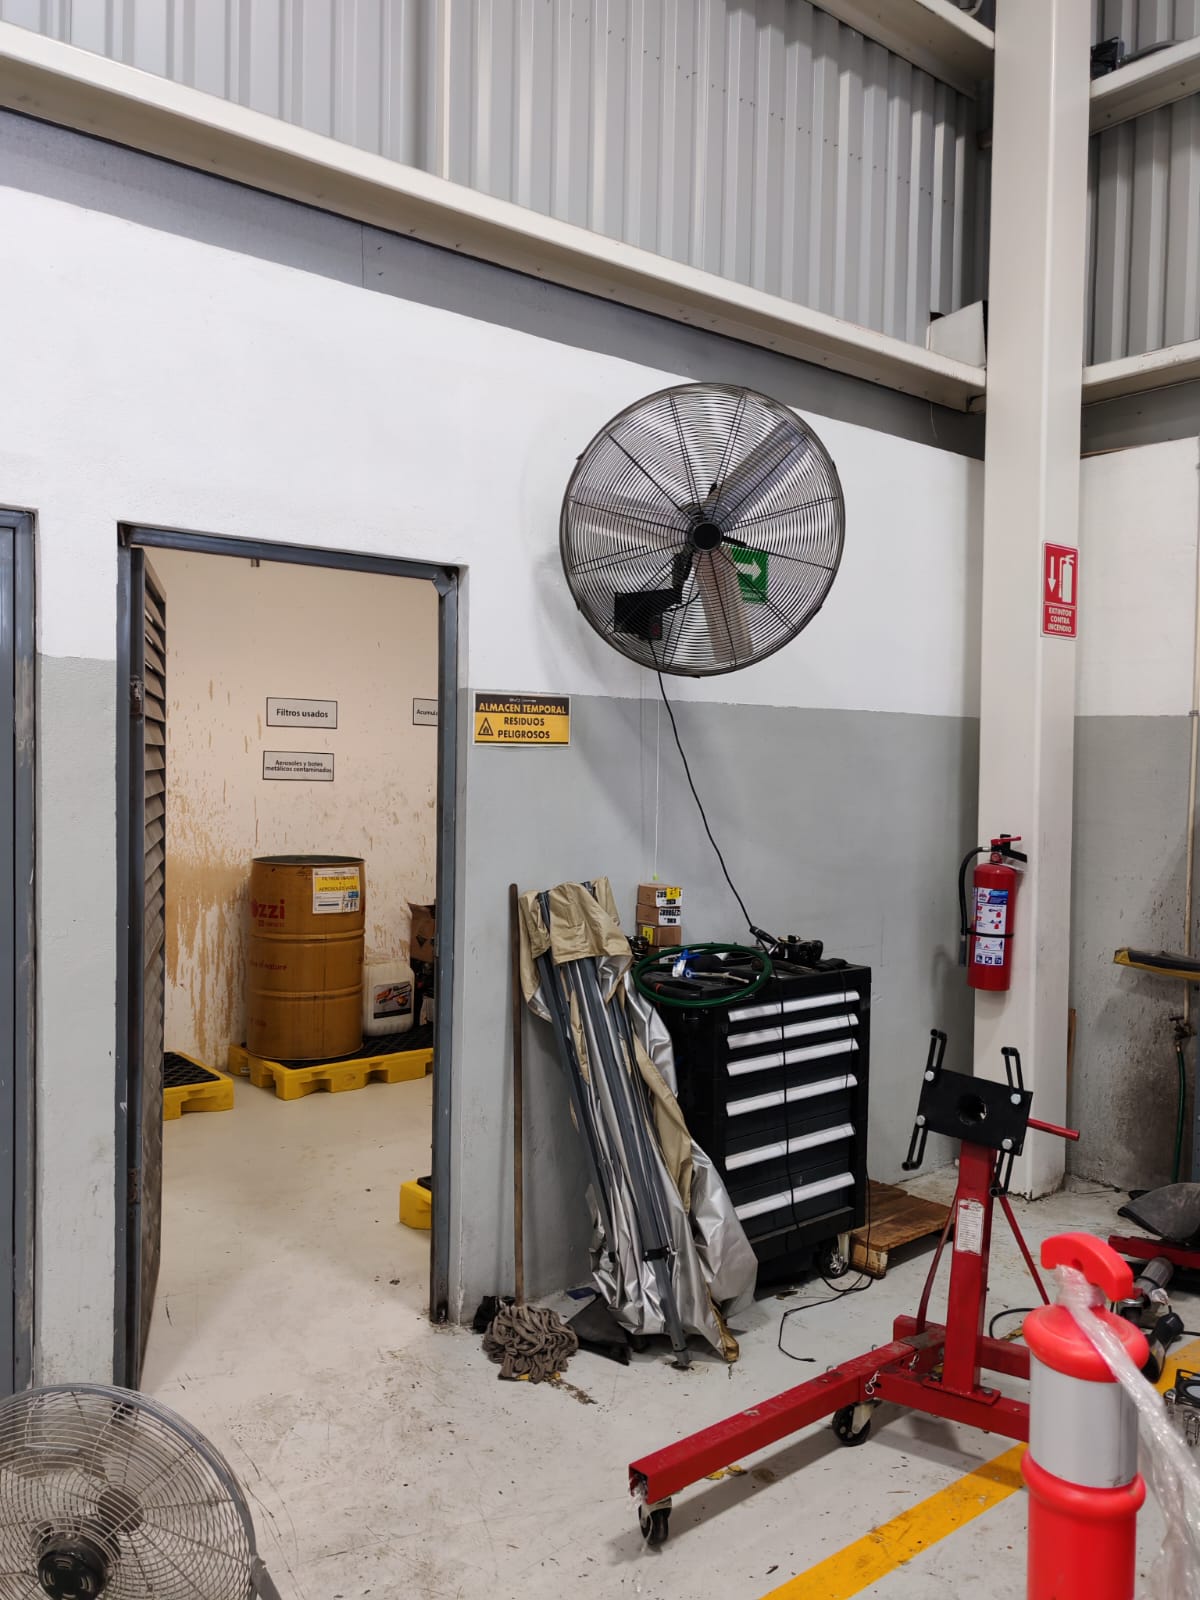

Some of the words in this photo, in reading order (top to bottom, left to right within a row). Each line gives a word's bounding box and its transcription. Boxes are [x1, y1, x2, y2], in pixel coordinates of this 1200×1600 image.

[1048, 607, 1072, 617] EXTINTOR
[1050, 615, 1070, 624] CONTRA
[1047, 623, 1072, 633] INCENDIO
[276, 708, 300, 717] Filtros
[301, 710, 329, 718] usados
[479, 702, 521, 713] ALMACEN
[523, 704, 566, 714] TEMPORAL
[504, 716, 545, 726] RESIDUOS
[498, 729, 550, 739] PELIGROSOS
[275, 759, 302, 767] Aerosoles
